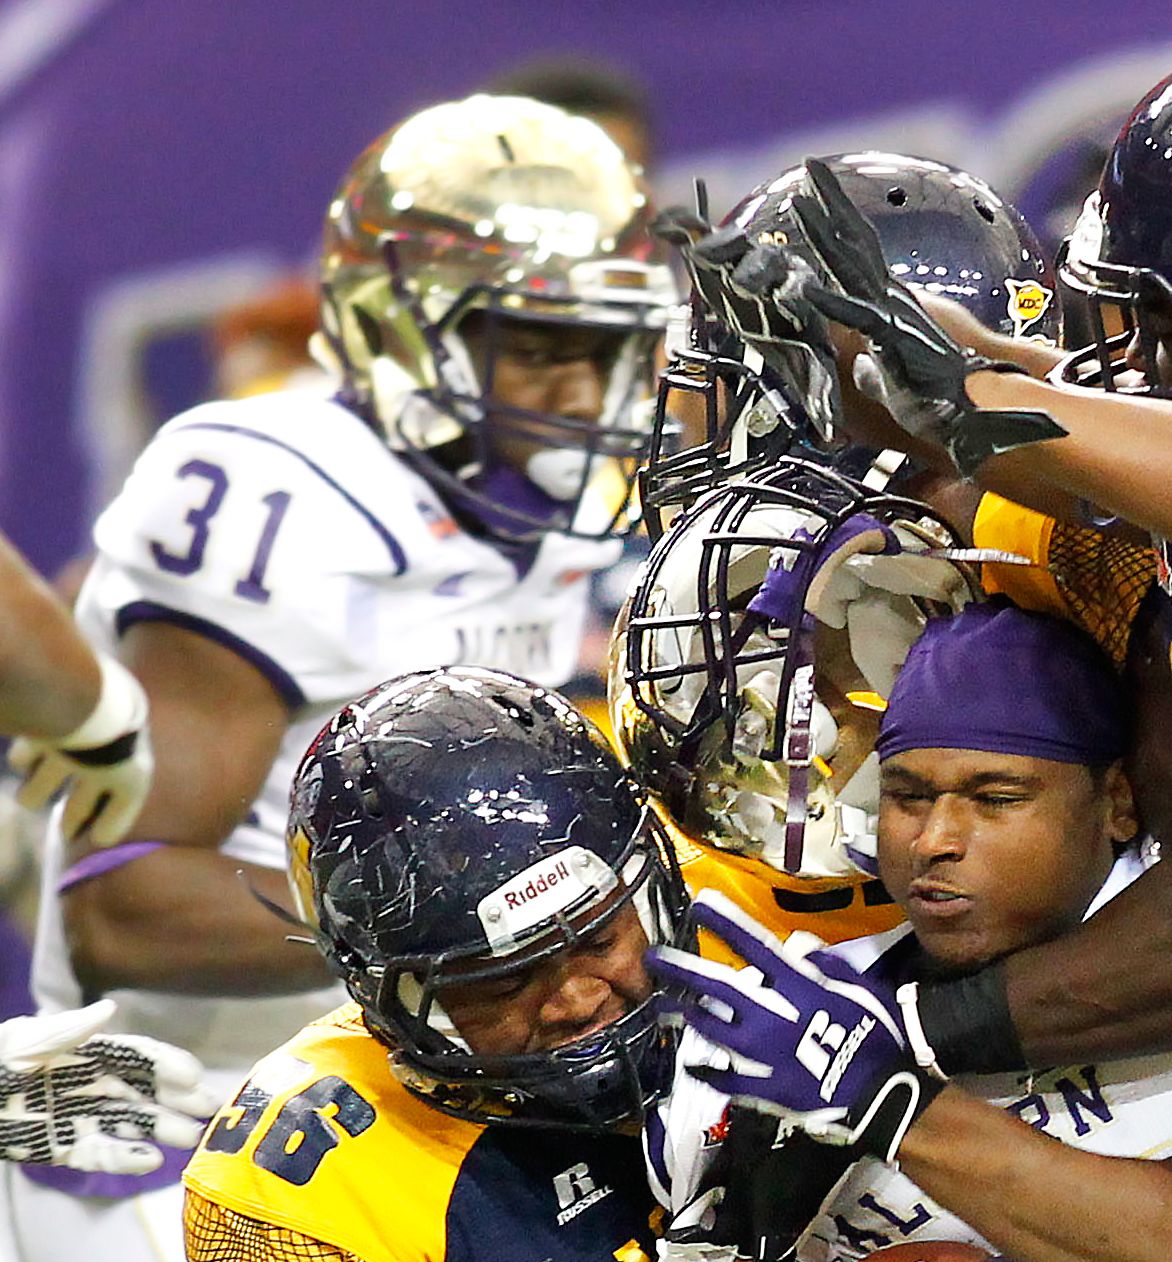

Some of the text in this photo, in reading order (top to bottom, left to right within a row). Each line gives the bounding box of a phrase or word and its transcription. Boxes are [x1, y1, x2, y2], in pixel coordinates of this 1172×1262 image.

[148, 458, 292, 605] 31
[503, 861, 570, 910] Riddell
[204, 1057, 377, 1187] 56
[556, 1185, 615, 1227] RUSSELL
